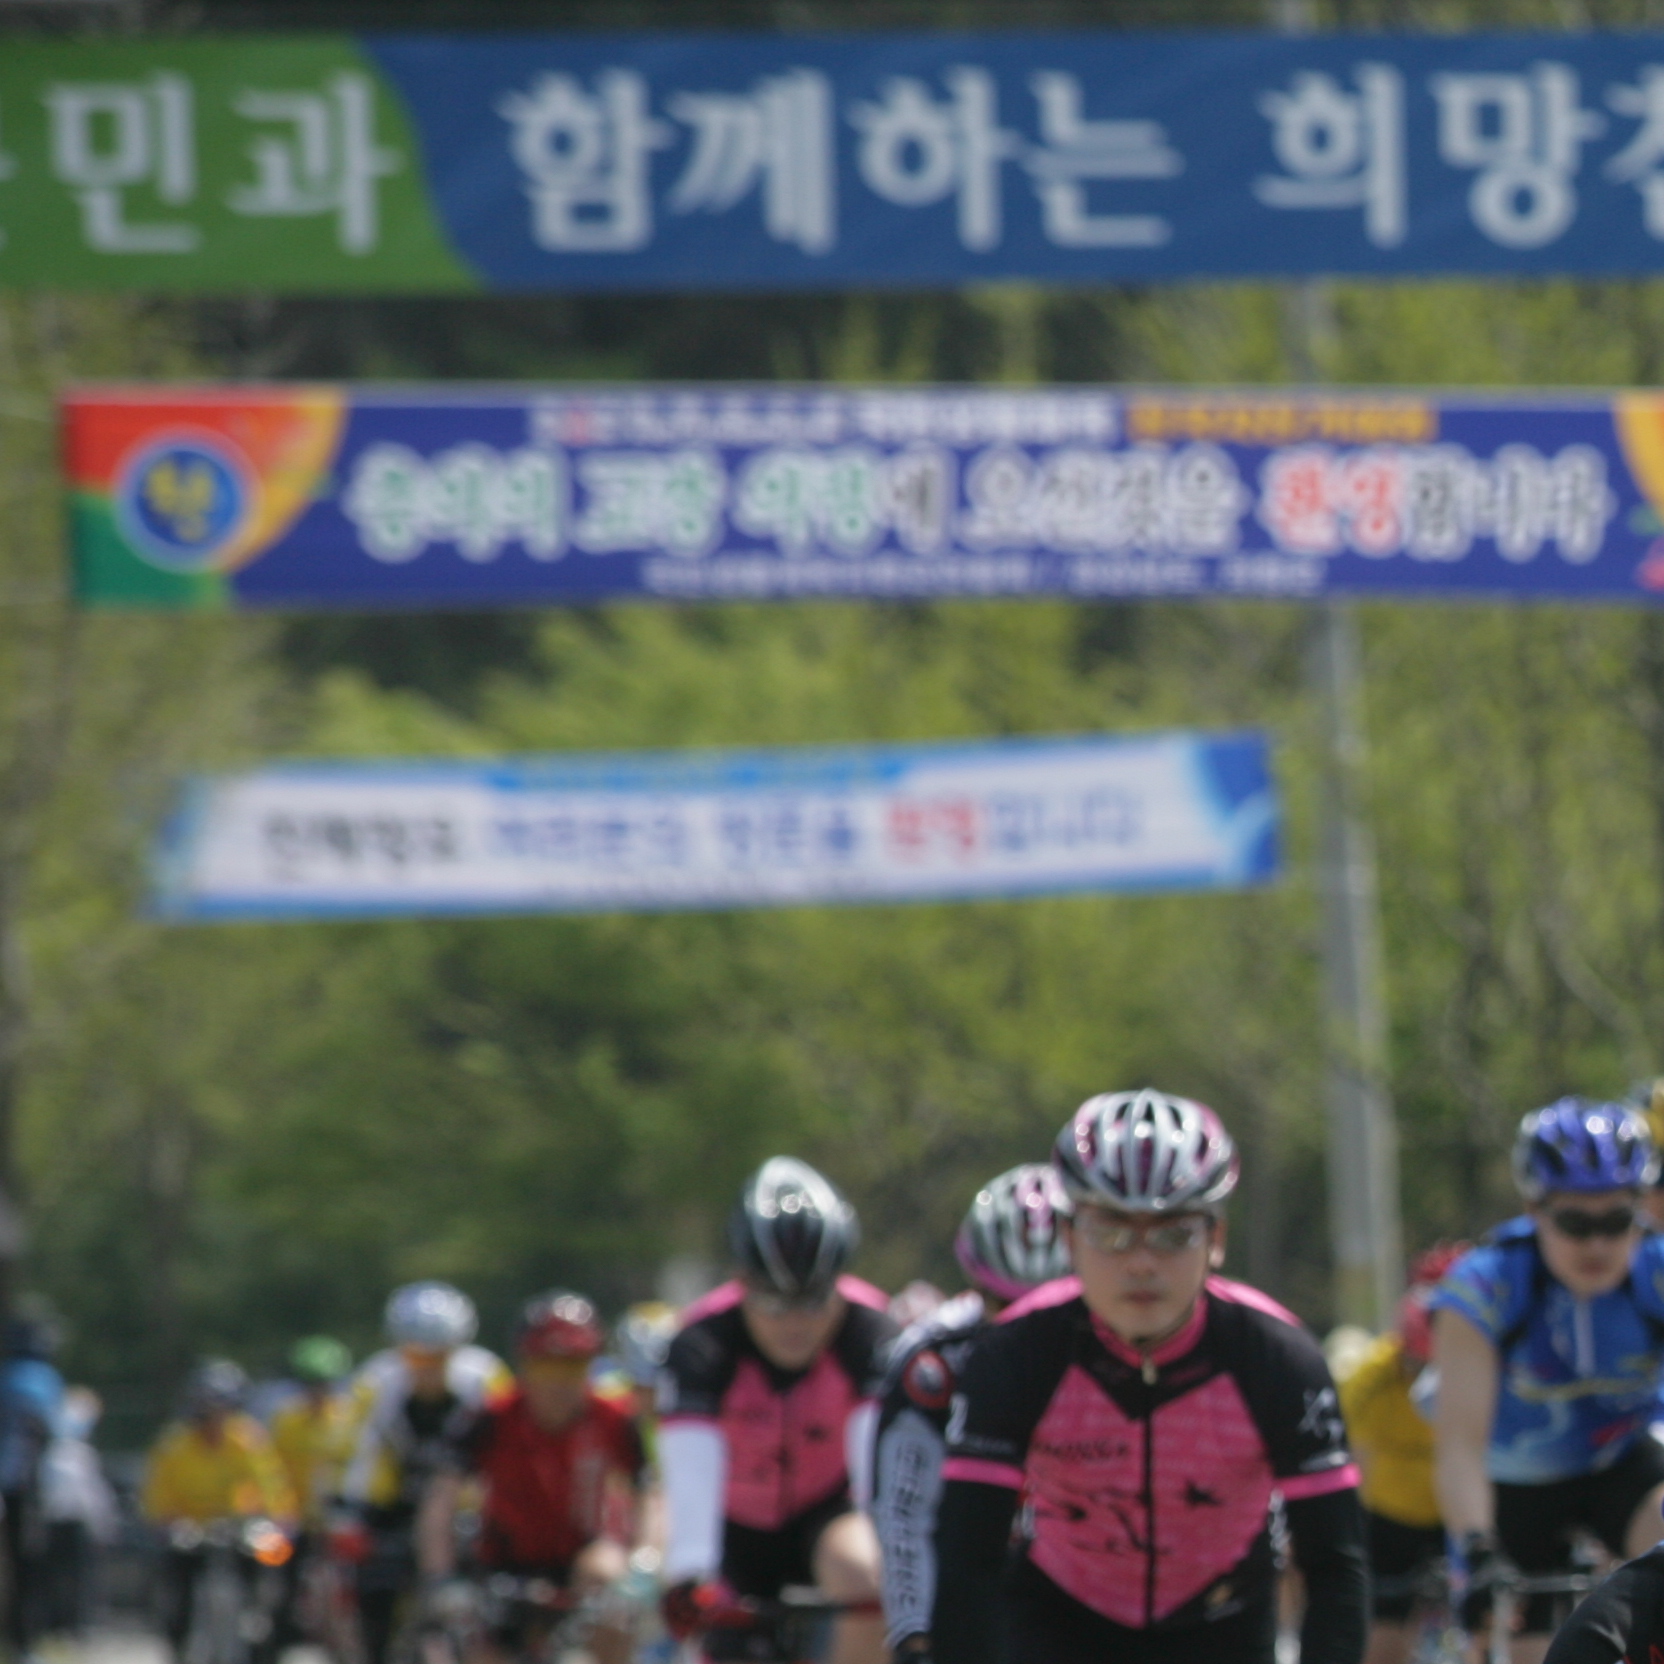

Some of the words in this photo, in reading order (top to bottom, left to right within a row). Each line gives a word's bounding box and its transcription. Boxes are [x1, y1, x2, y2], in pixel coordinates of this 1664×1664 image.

[0, 70, 405, 256] 민과
[494, 67, 1184, 254] 함께하는
[1259, 442, 1617, 562] 환영합니다
